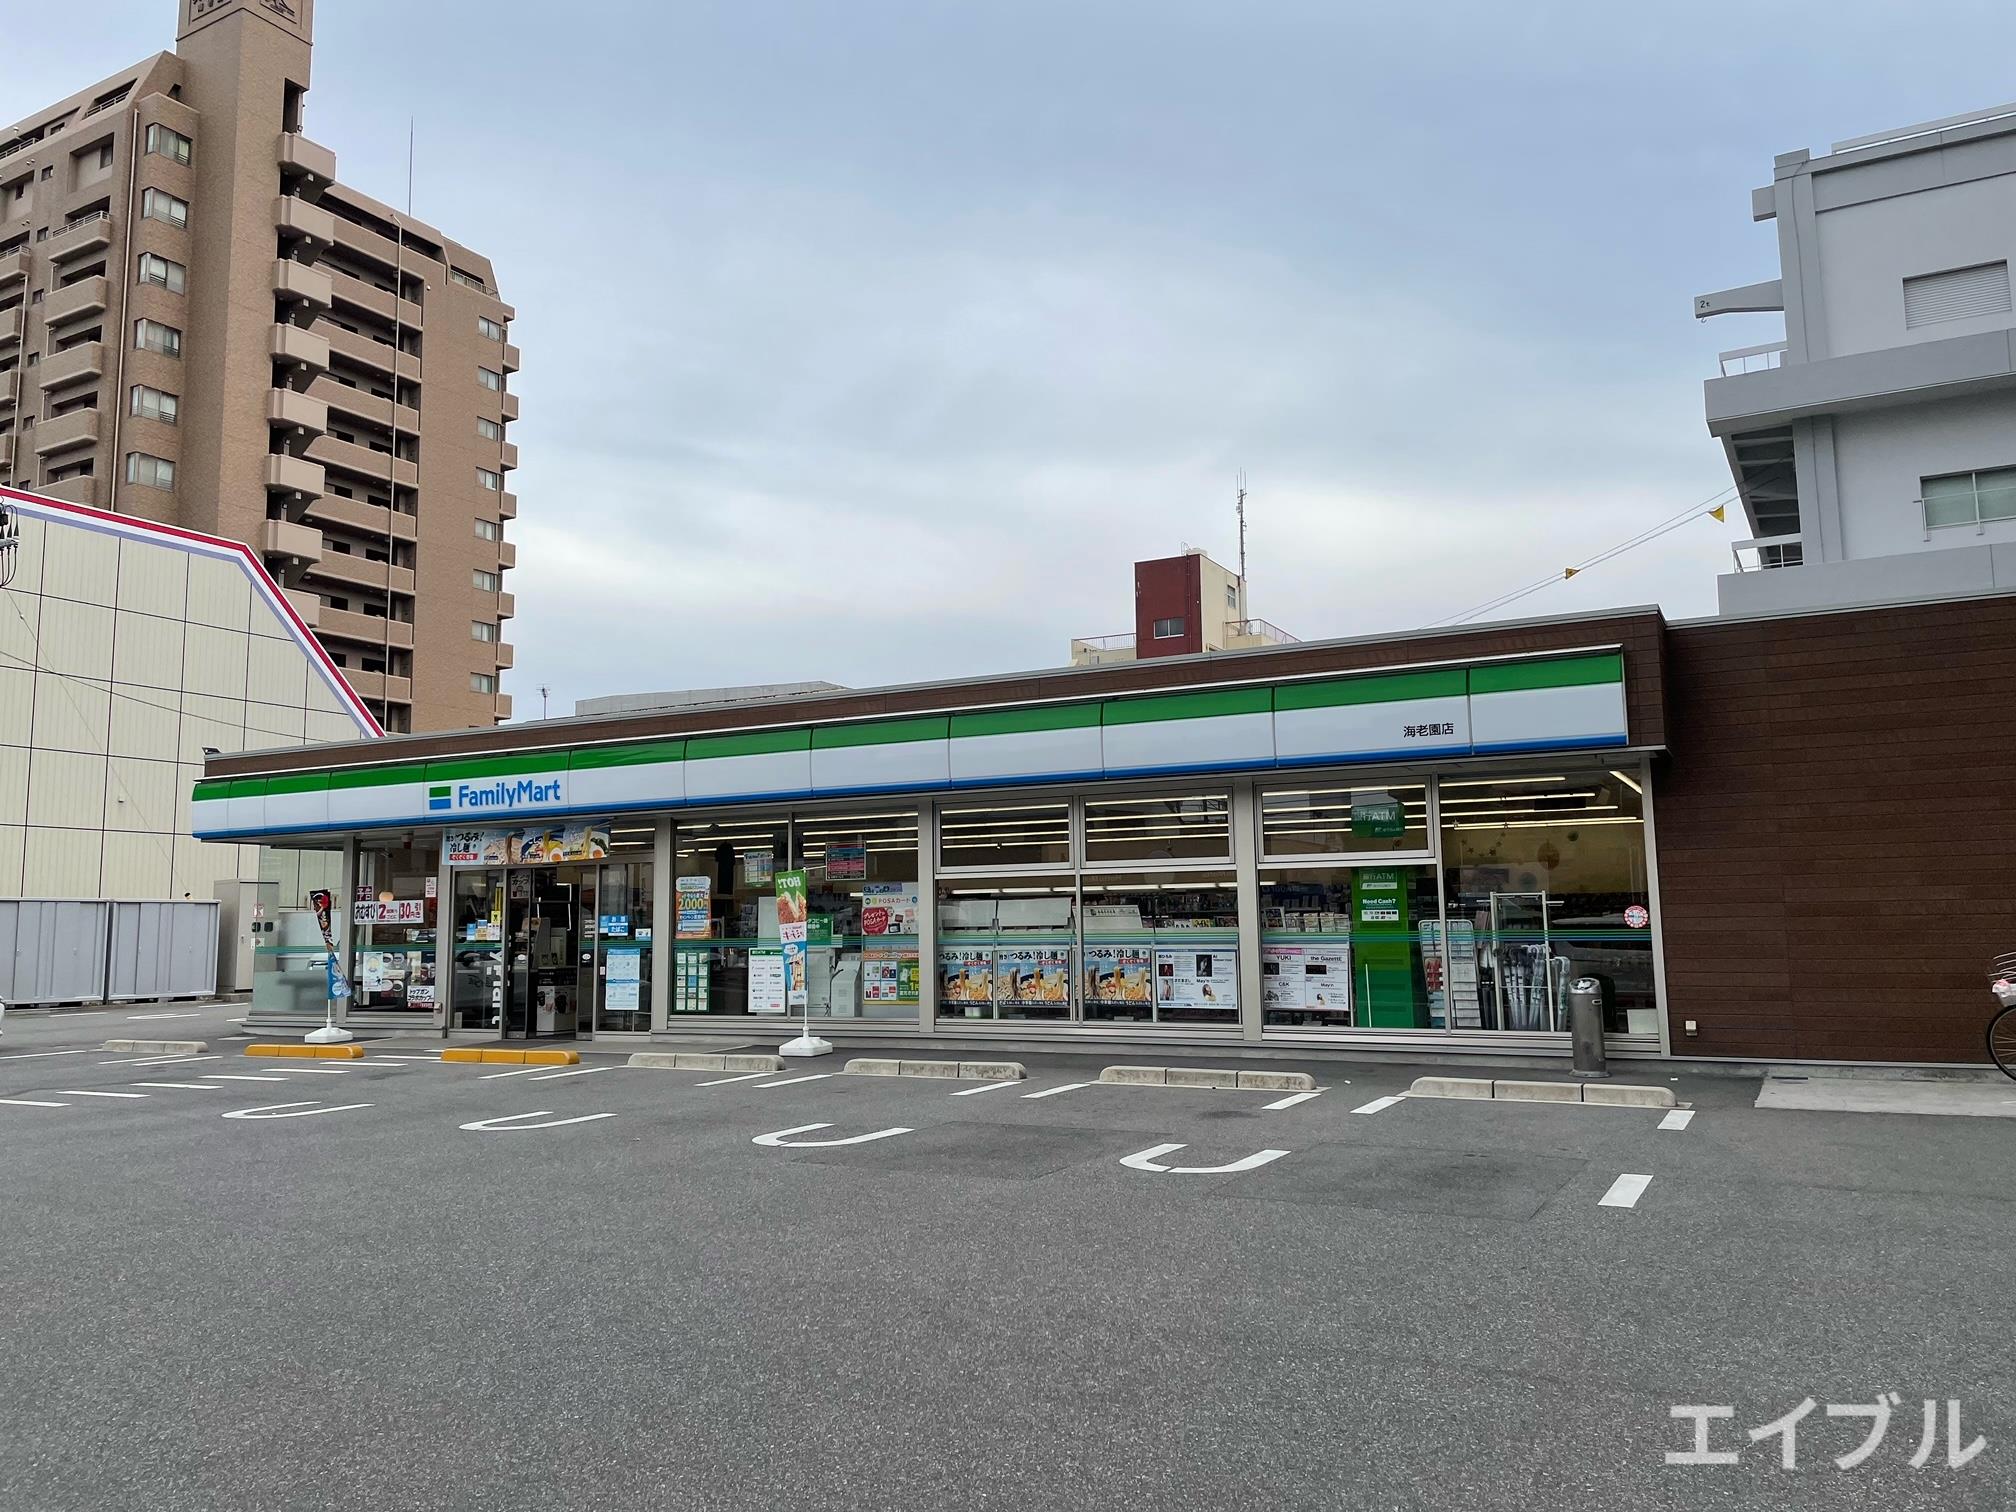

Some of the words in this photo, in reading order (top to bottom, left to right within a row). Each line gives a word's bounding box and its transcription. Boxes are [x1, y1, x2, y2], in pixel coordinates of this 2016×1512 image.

[1403, 723, 1454, 738] 海老園店
[459, 780, 560, 807] FamilyMart
[355, 904, 376, 920] おむすび
